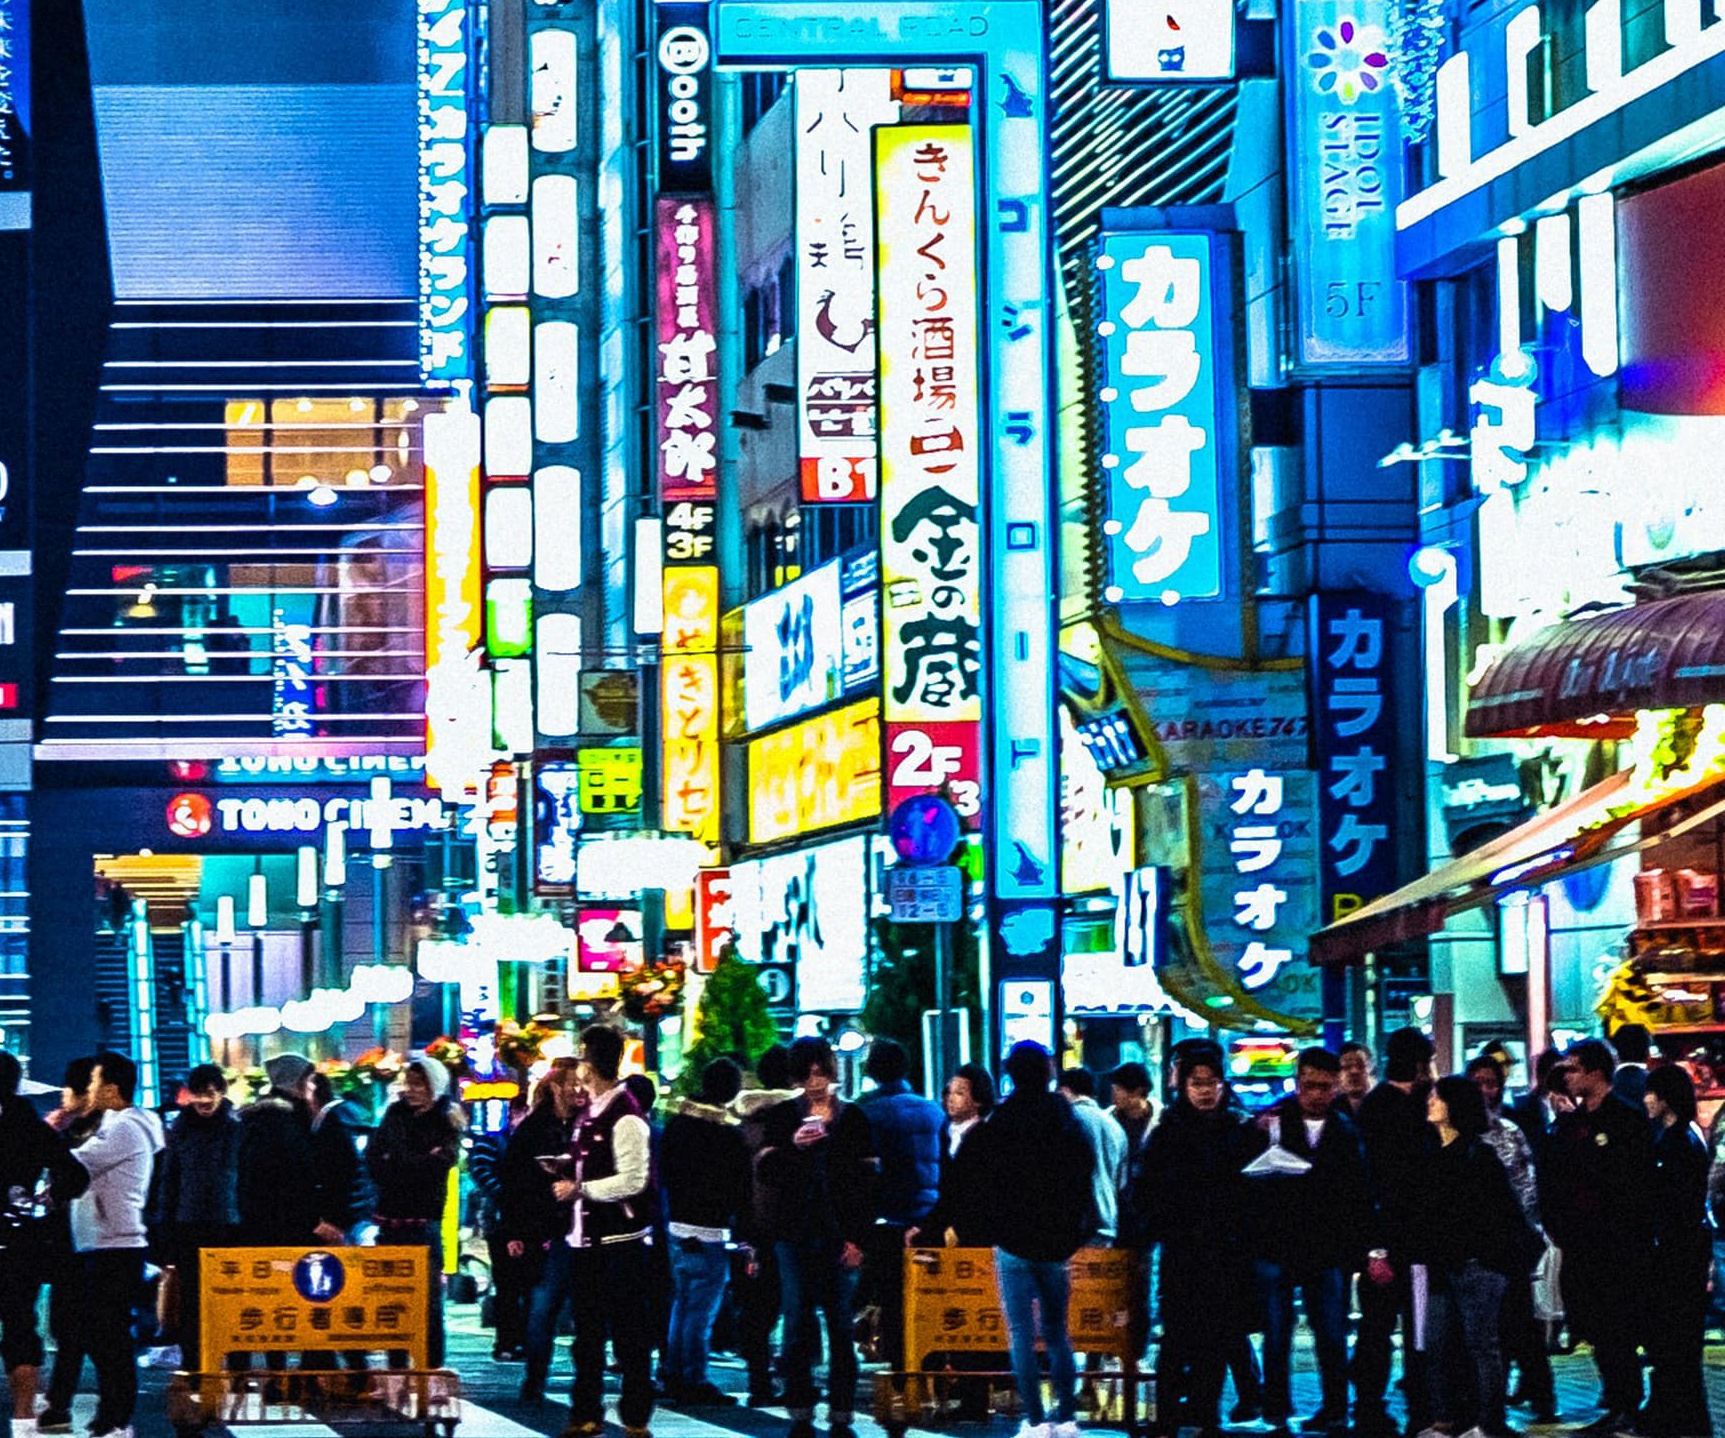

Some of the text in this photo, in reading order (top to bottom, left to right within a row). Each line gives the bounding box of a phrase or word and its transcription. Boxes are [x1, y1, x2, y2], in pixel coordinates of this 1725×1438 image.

[658, 26, 711, 162] Booth
[1323, 113, 1353, 239] STAGE
[1353, 114, 1382, 213] IDOL
[910, 142, 957, 410] きんくら酒場
[1326, 281, 1382, 318] 5F
[657, 330, 716, 482] 甘太郎
[1119, 244, 1210, 584] カラオケ
[666, 502, 714, 530] 4F
[817, 456, 877, 499] B1
[666, 532, 714, 561] 3F
[891, 485, 980, 708] 金の蔵
[891, 730, 964, 788] 2F
[1327, 608, 1388, 878] カラオケ
[1229, 769, 1292, 991] カラオケ
